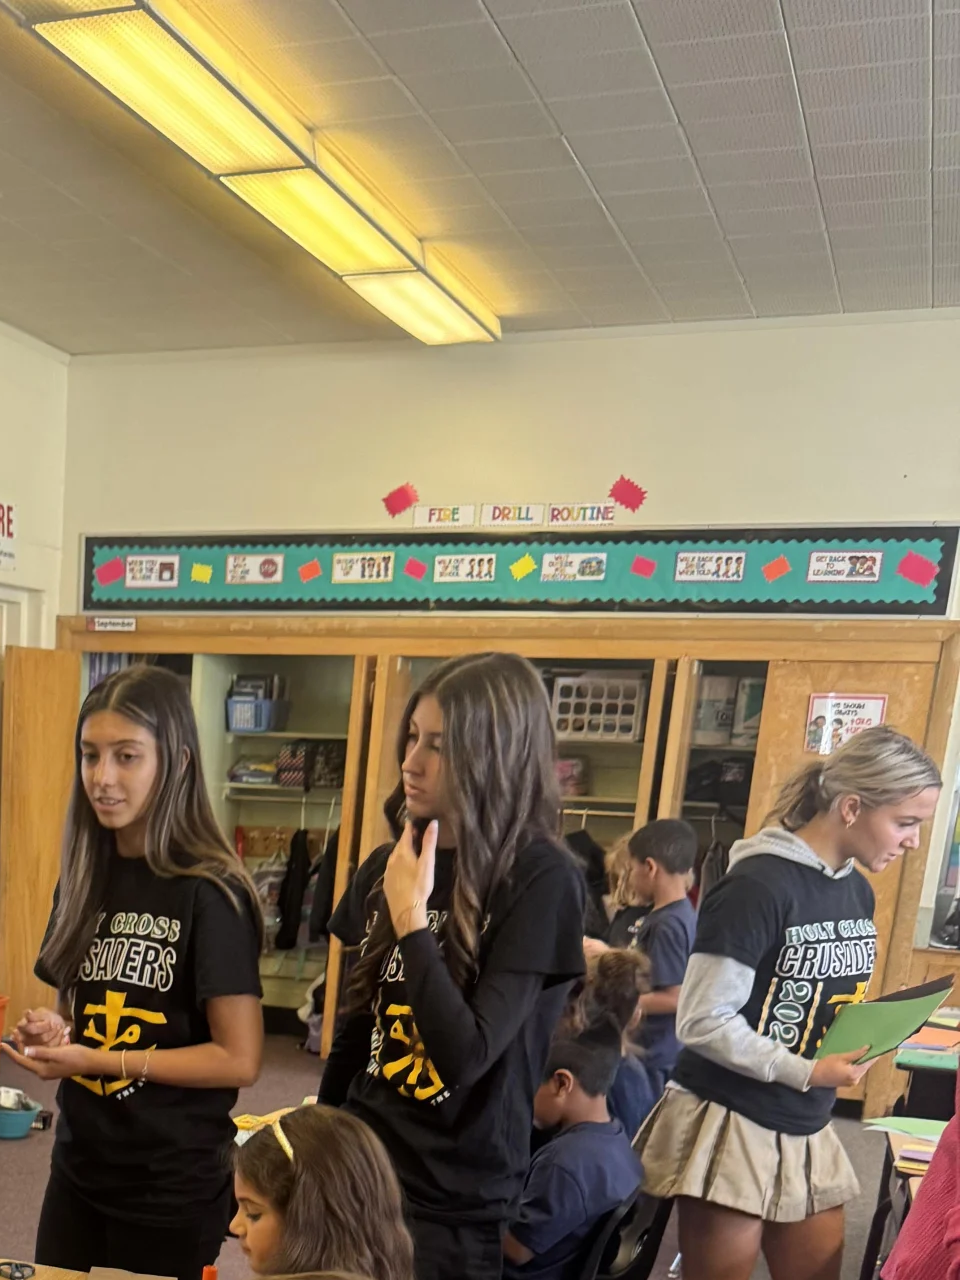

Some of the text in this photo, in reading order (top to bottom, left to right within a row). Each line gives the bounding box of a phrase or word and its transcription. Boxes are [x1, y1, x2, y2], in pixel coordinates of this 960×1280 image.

[428, 506, 614, 522] FIRE DRILL ROUTINE
[97, 620, 134, 628] September
[111, 912, 181, 942] CROSS
[786, 921, 835, 945] HOLY
[768, 980, 813, 1047] 202
